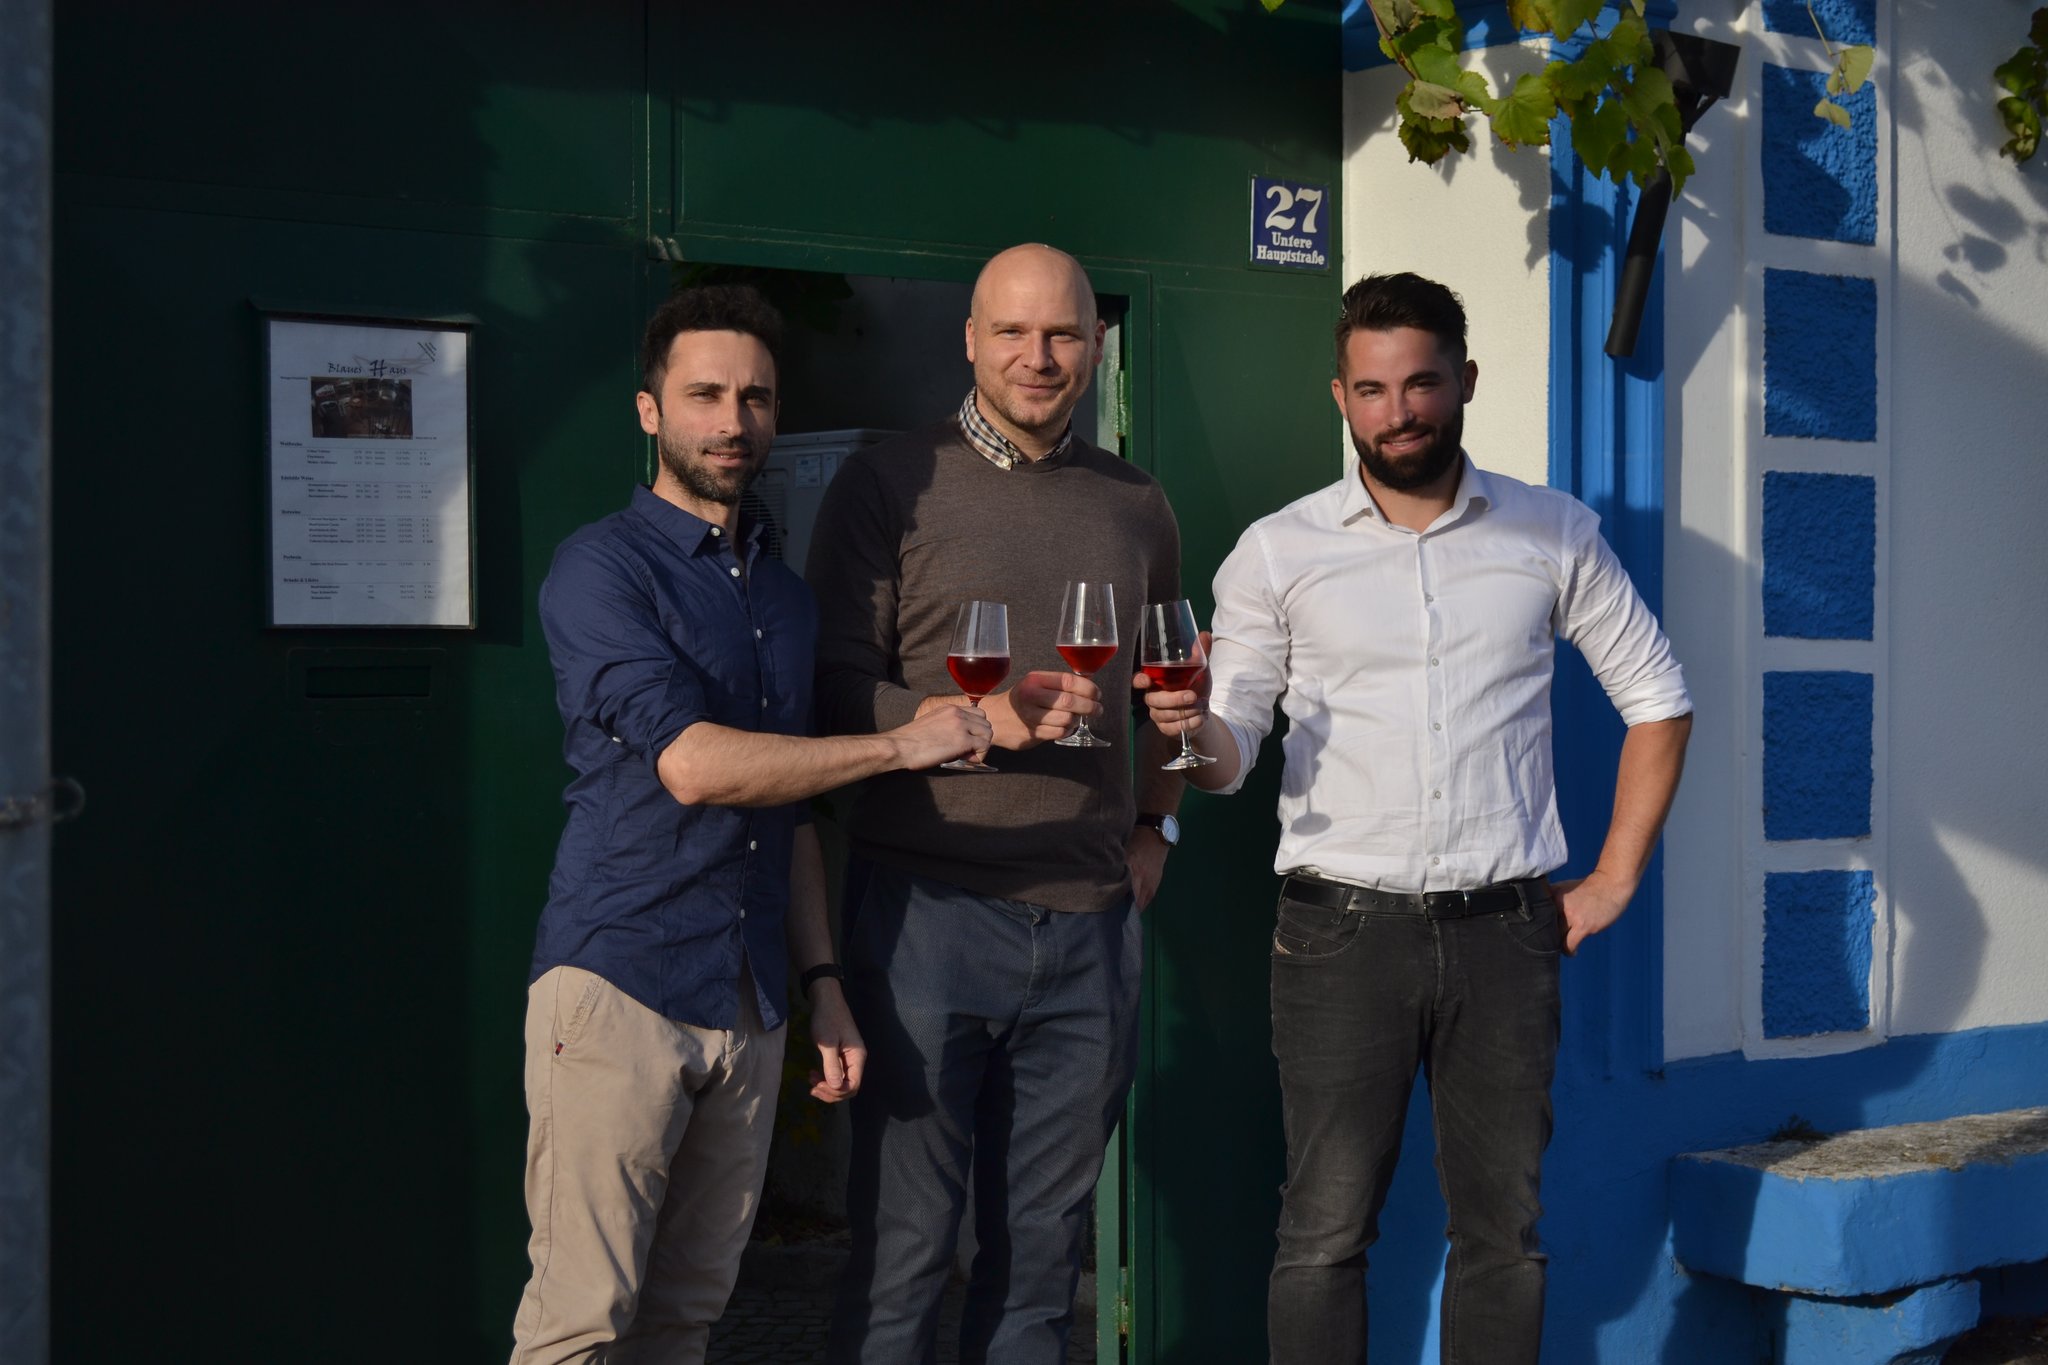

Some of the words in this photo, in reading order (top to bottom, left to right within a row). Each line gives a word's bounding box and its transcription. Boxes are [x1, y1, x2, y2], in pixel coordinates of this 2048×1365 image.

[1265, 185, 1322, 233] 27
[1272, 231, 1312, 249] Untere
[1256, 245, 1325, 265] Hauptstraße
[328, 362, 362, 374] Blaues
